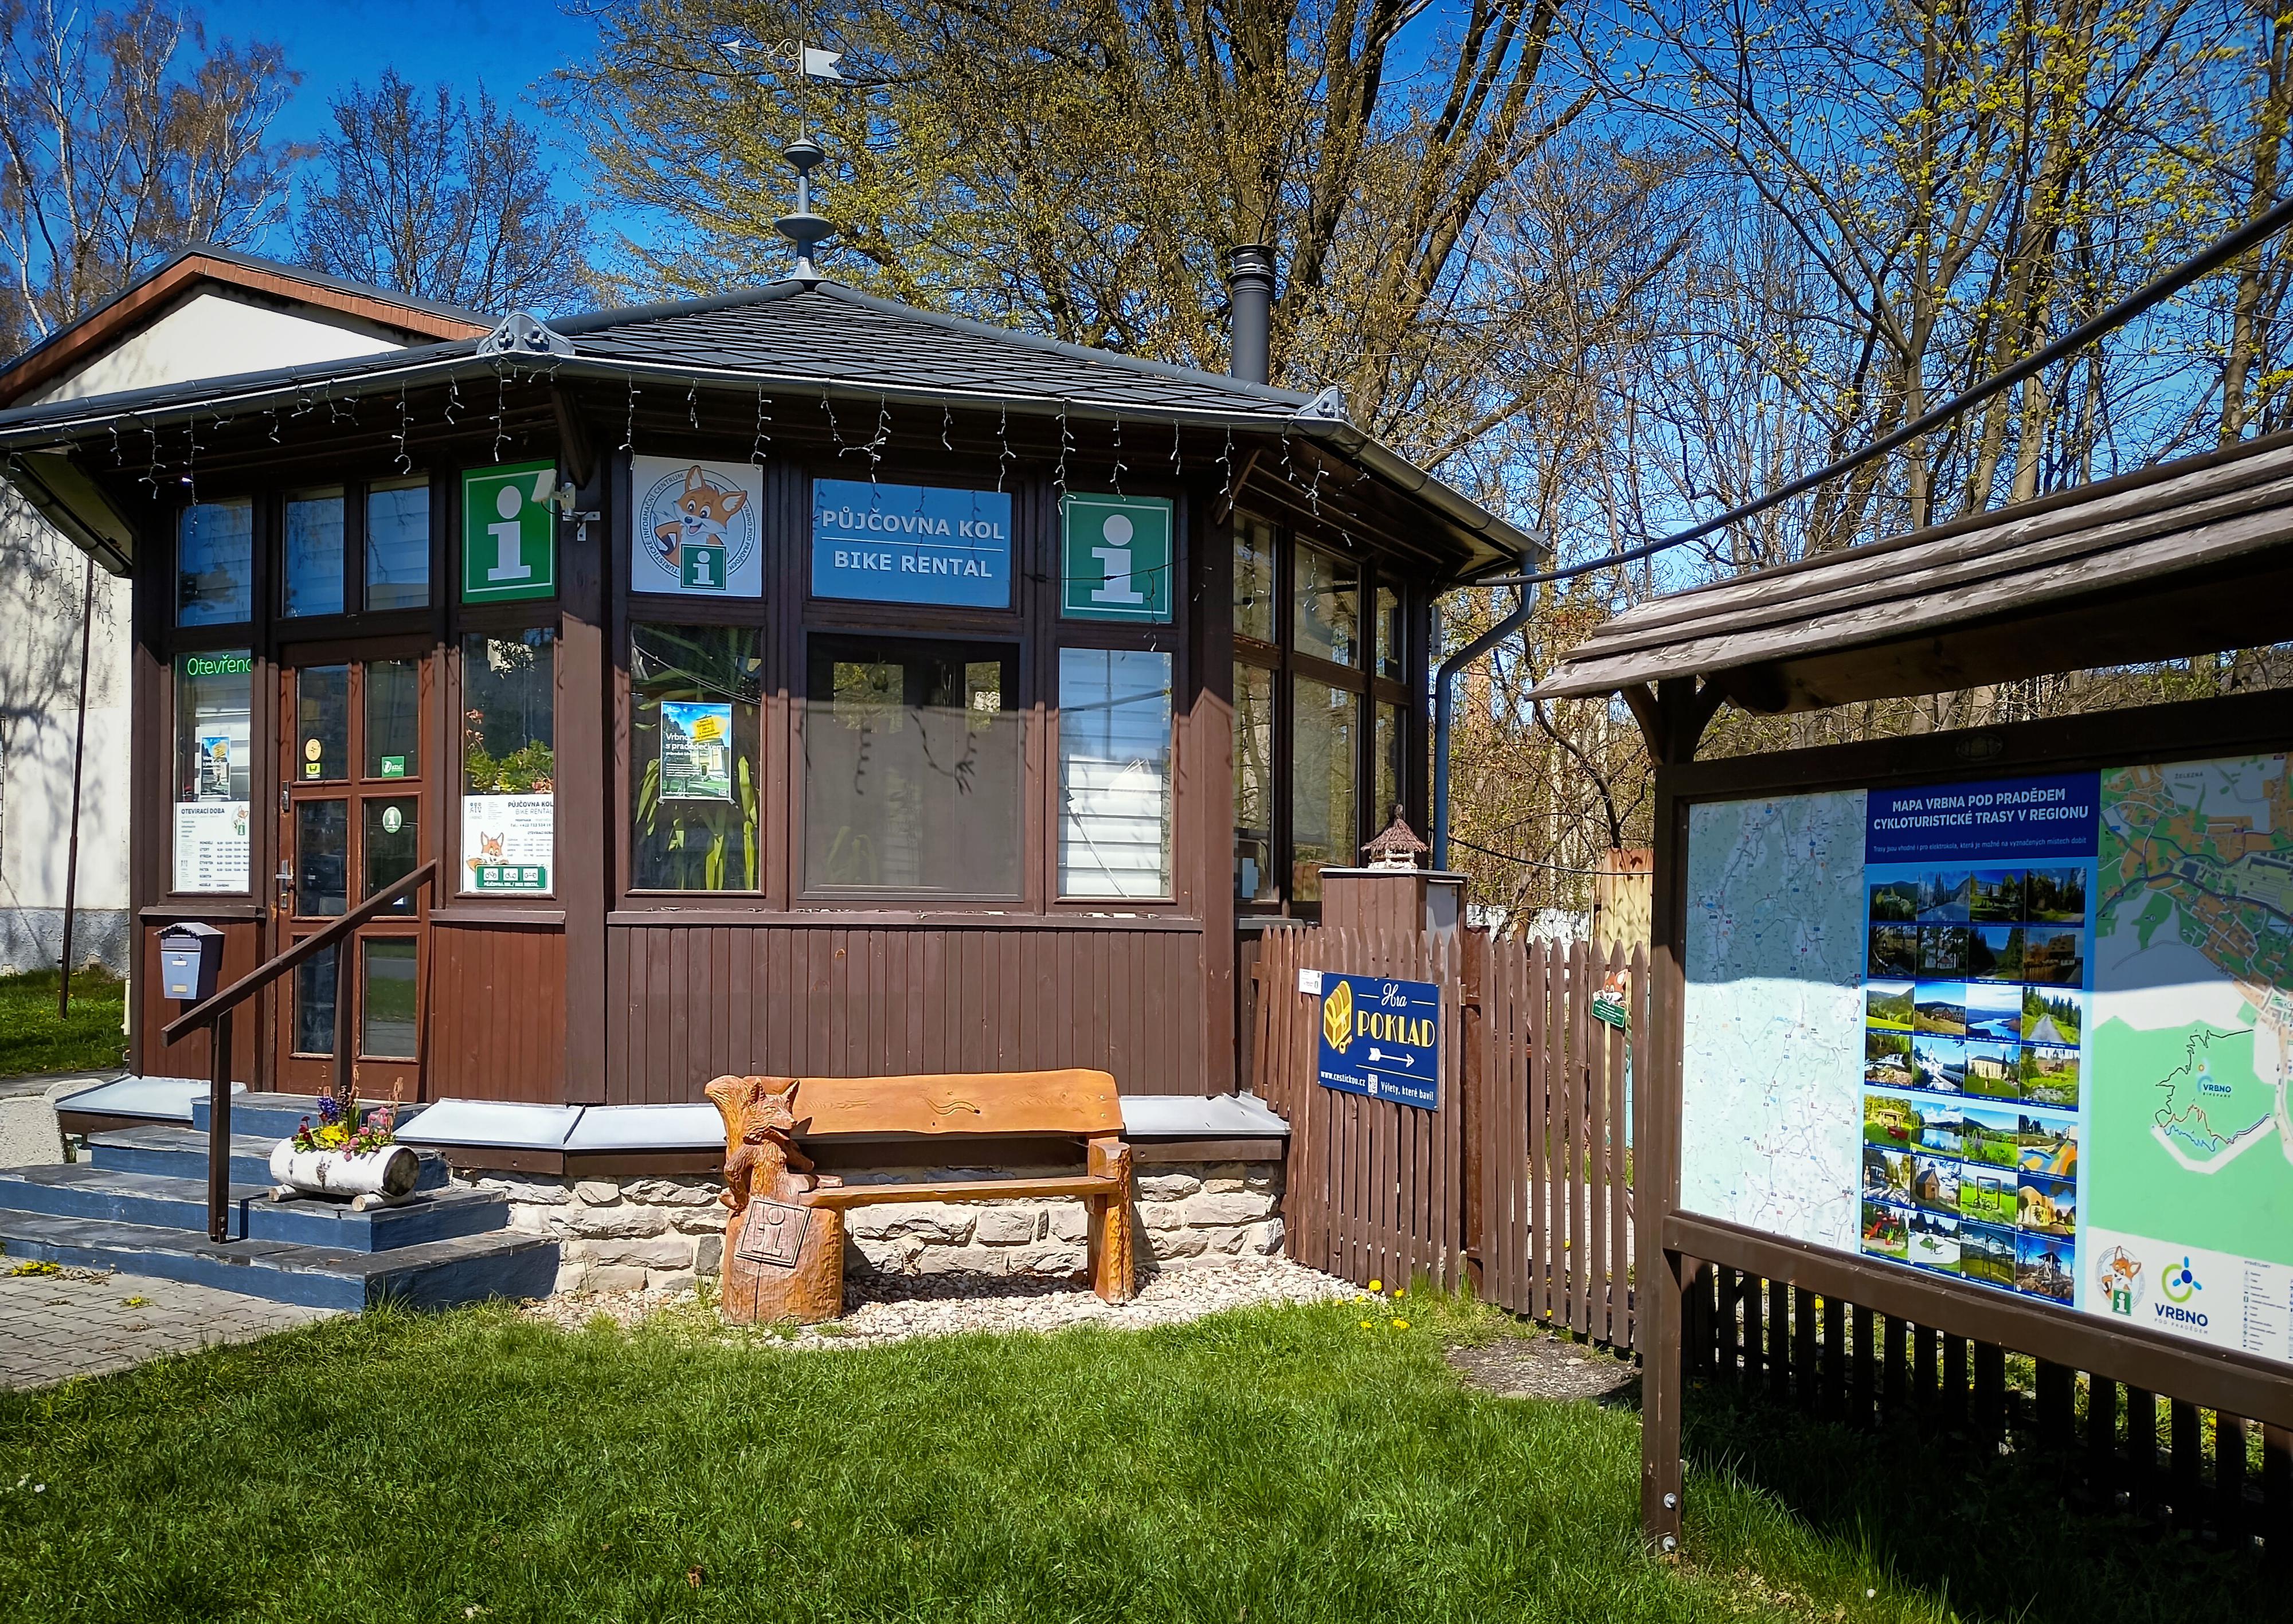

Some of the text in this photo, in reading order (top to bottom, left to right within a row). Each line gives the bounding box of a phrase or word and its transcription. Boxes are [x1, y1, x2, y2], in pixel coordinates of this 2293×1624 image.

[643, 495, 656, 539] INFORMAČNÍ
[655, 473, 684, 494] CENTRUM
[743, 504, 752, 528] VRBNO
[822, 506, 1005, 540] PŮJČOVNA KOL
[835, 550, 992, 577] BIKE RENTAL
[1892, 788, 2065, 812] MAPA VRBNA POD PRADĚDEM
[1873, 805, 2089, 829] CYKLOTURISTICKÉ TRASY V REGIONU
[1381, 983, 1407, 1007] Hra
[1357, 1010, 1435, 1047] POKLAD
[1381, 1081, 1400, 1095] Výlety,
[1402, 1086, 1418, 1098] které
[1419, 1089, 1434, 1101] baví!
[2203, 1083, 2232, 1093] VRBNO
[2155, 1303, 2208, 1327] VRBNO
